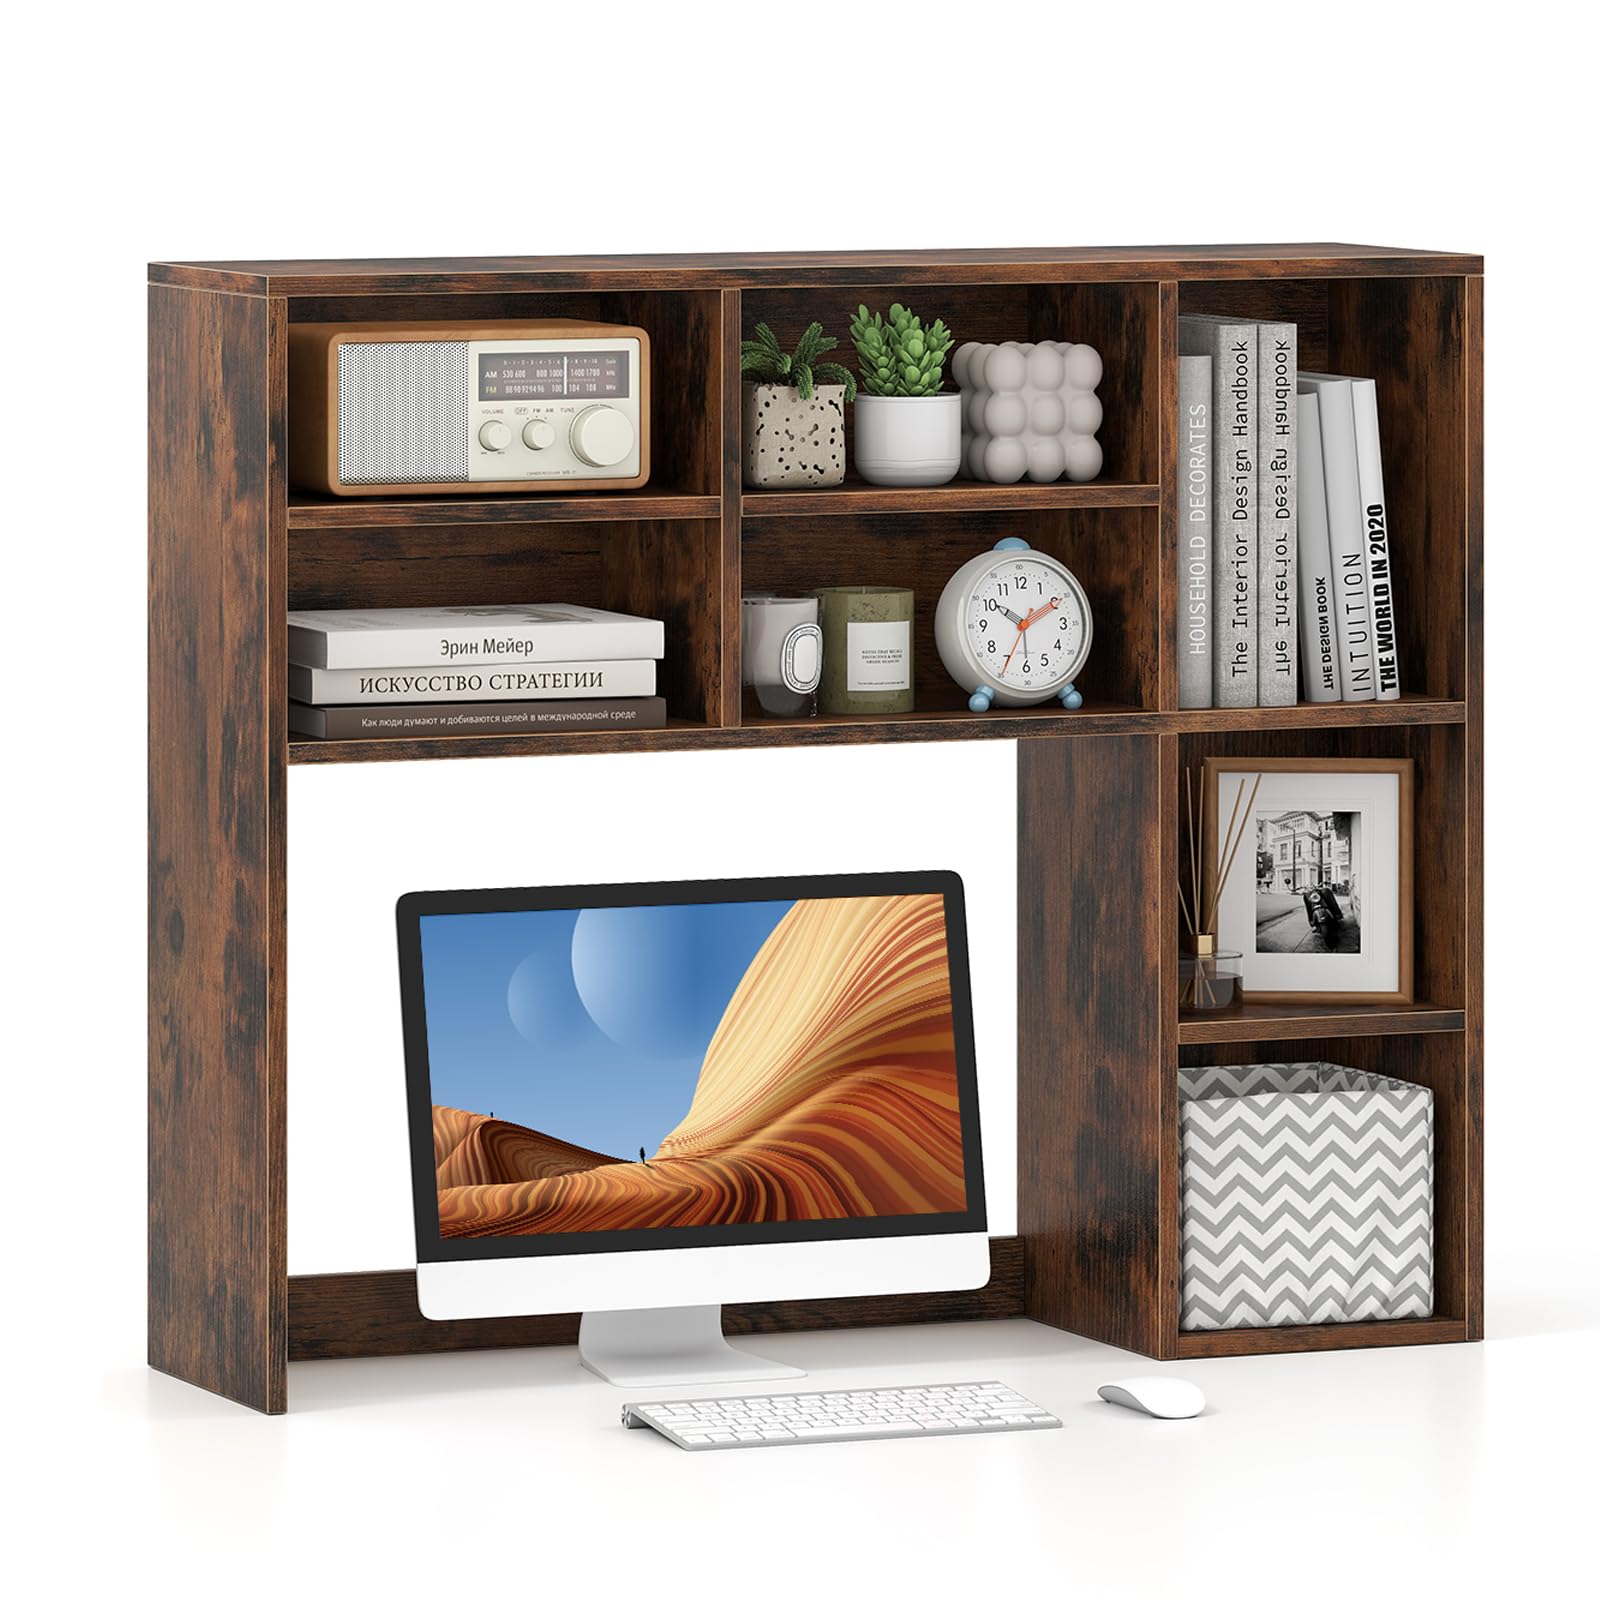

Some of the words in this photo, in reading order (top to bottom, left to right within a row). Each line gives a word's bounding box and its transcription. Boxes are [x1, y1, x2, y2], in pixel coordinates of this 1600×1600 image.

[502, 370, 513, 378] 530
[515, 370, 526, 378] 600
[536, 369, 547, 377] 800
[550, 369, 563, 377] 1000
[570, 368, 584, 377] 1400
[586, 368, 600, 376] 1700
[586, 383, 596, 391] 108
[1232, 341, 1248, 436] Handbook
[1189, 404, 1206, 521] DECORATES
[1231, 450, 1252, 520] Design
[1367, 504, 1386, 555] 2020
[1371, 559, 1388, 579] IN
[998, 583, 1008, 596] 11
[1014, 576, 1027, 589] 12
[1038, 582, 1042, 595] 1
[1231, 534, 1247, 628] Interior
[1189, 536, 1206, 654] HOUSEHOLD
[983, 599, 997, 611] 10
[979, 619, 988, 632] 9
[1059, 617, 1067, 630] 3
[1342, 554, 1371, 692] INTUITION
[1373, 584, 1394, 654] WORLD
[441, 639, 478, 658] Эрин
[483, 637, 534, 656] Мейер
[988, 640, 996, 653] 8
[1054, 639, 1061, 650] 4
[1022, 660, 1030, 673] 6
[1041, 654, 1049, 666] 5
[1232, 642, 1247, 677] The
[360, 675, 482, 693] ИСКУССТВО
[489, 672, 603, 690] СТРАТЕГИИ
[1379, 656, 1397, 692] THE
[362, 718, 378, 727] Как
[379, 718, 402, 728] люди
[404, 717, 437, 728] думают
[447, 715, 500, 725] добиваются
[502, 712, 528, 723] целей
[537, 710, 608, 722] международной
[610, 710, 636, 720] среде
